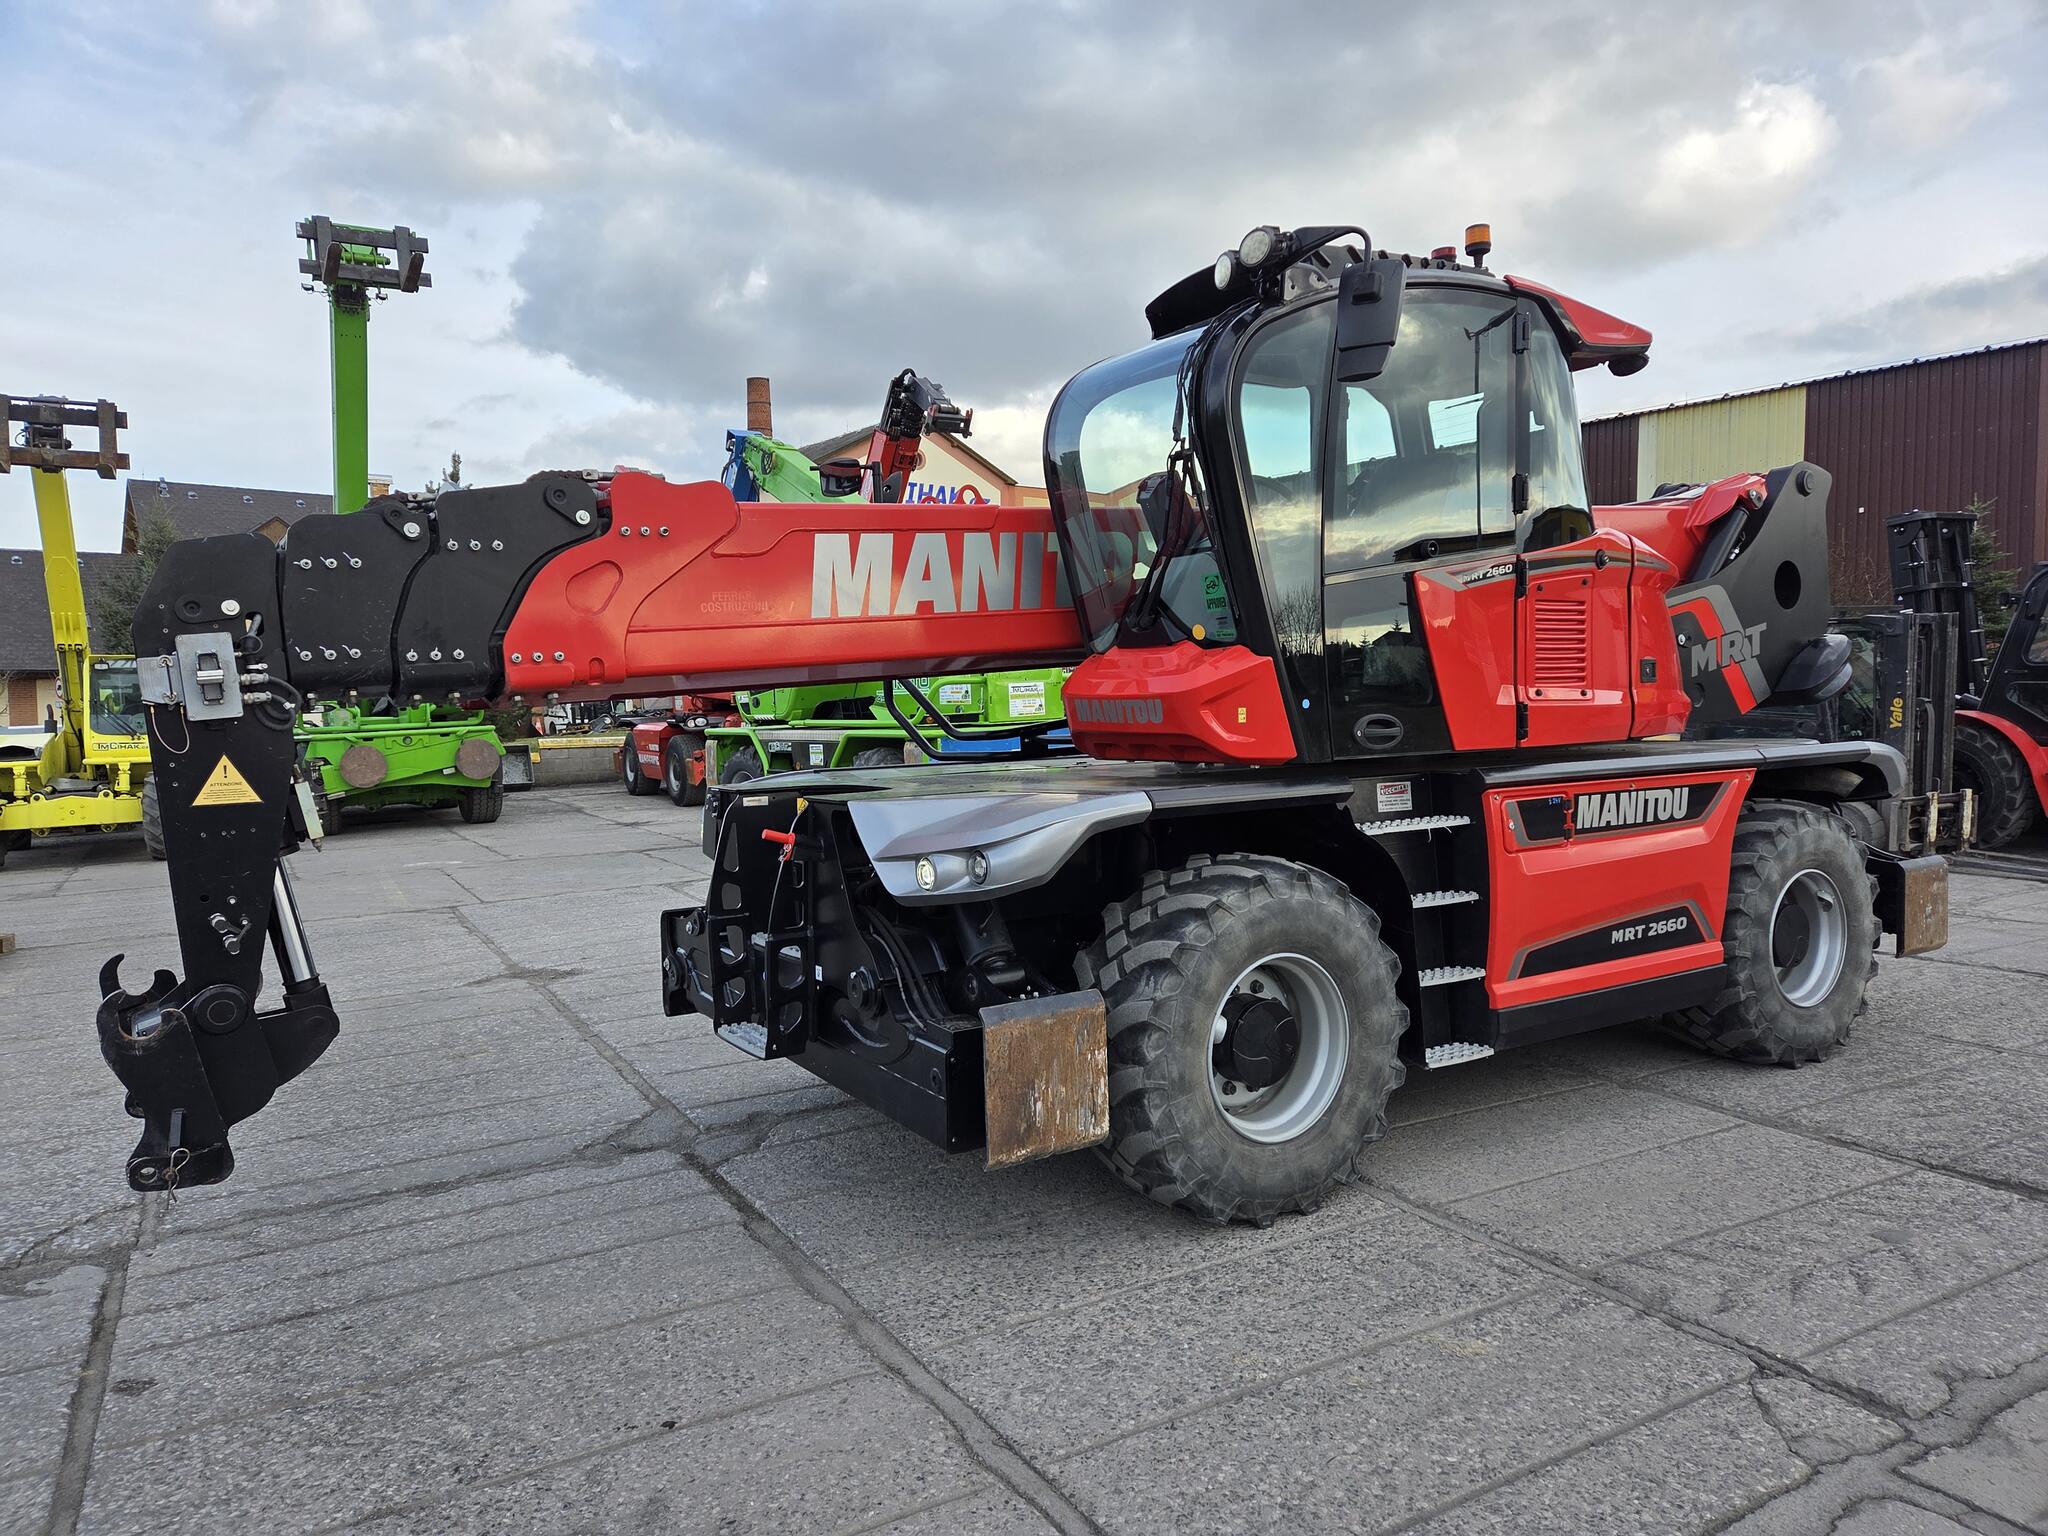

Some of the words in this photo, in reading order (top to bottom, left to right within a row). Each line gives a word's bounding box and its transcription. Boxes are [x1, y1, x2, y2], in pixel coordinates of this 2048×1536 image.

[1486, 564, 1513, 577] 2660
[1691, 622, 1767, 678] MRT
[1075, 699, 1163, 724] MANITOU
[1889, 697, 1904, 729] Yale
[1576, 787, 1690, 830] MANITOU
[1611, 924, 1646, 945] MRT
[1647, 916, 1688, 937] 2660
